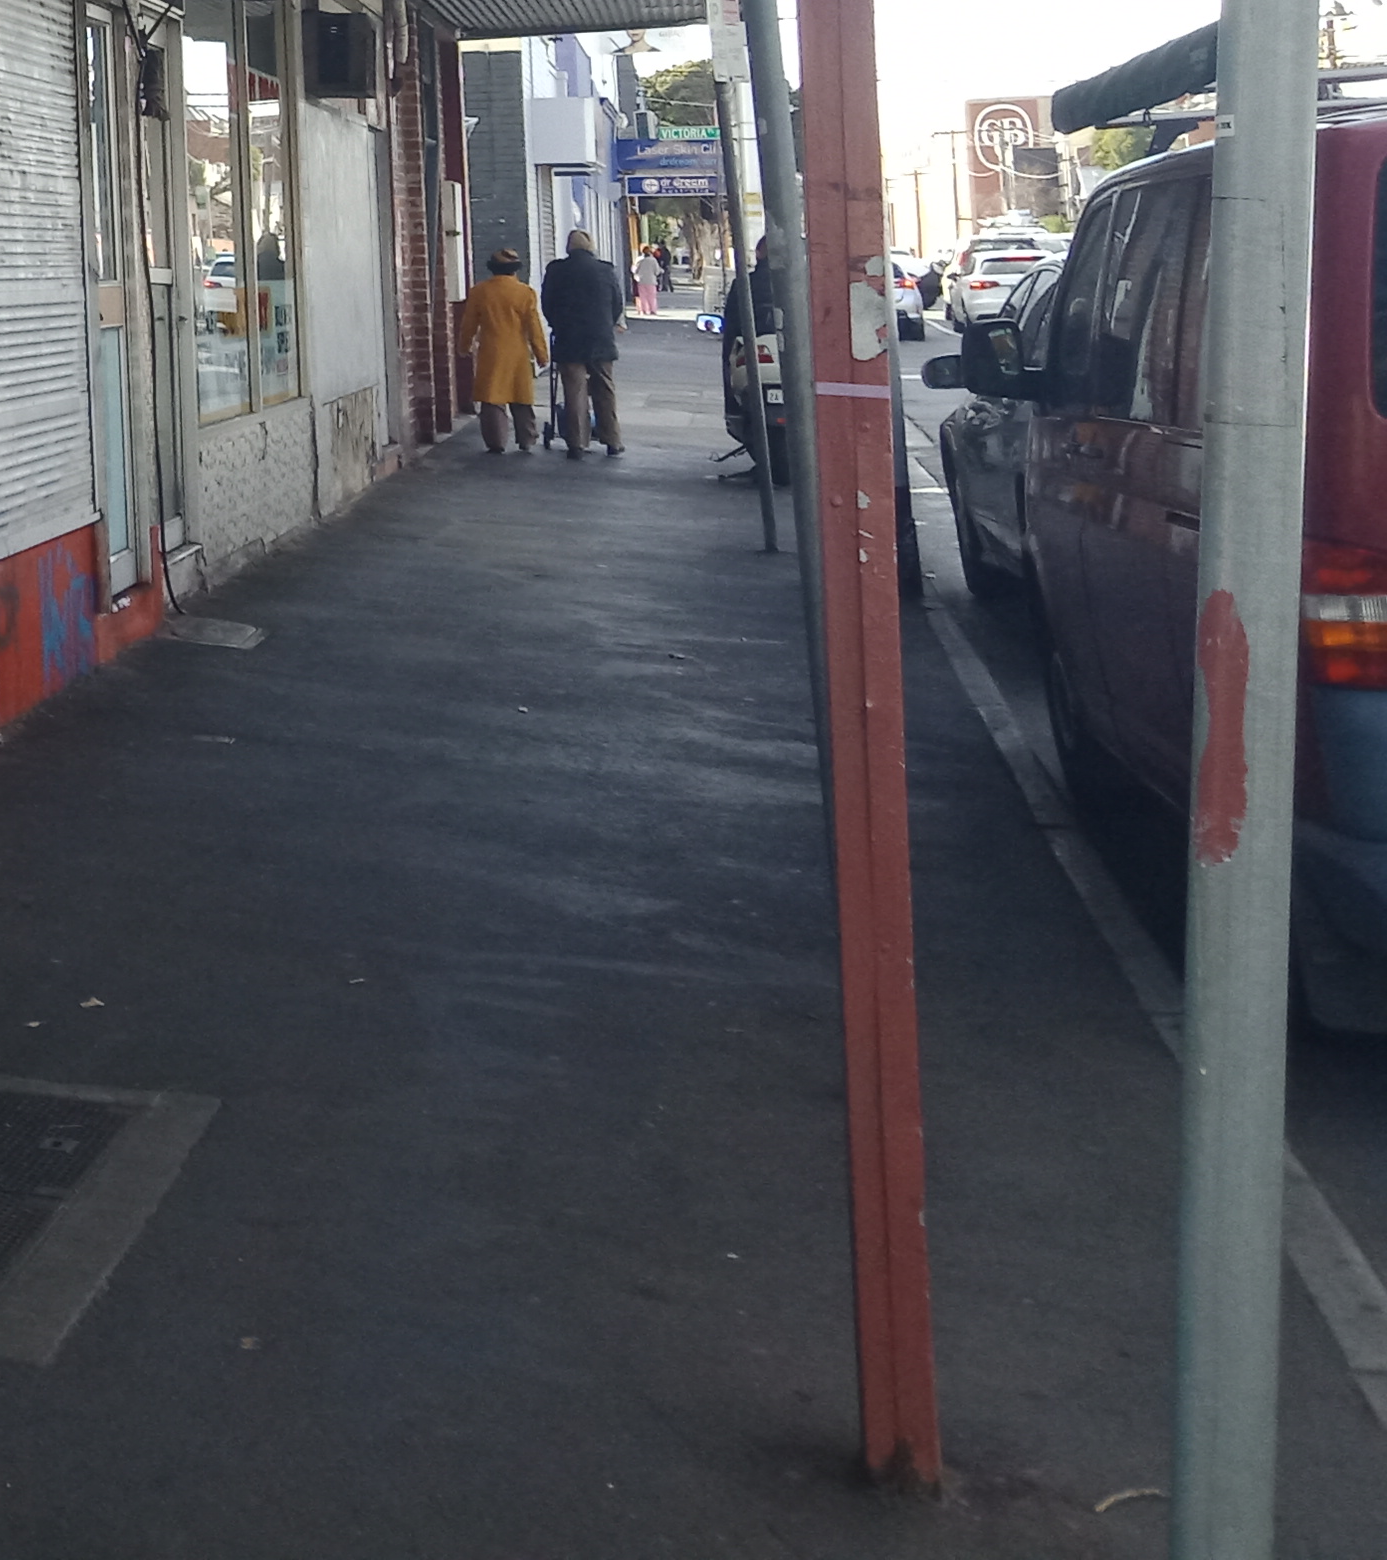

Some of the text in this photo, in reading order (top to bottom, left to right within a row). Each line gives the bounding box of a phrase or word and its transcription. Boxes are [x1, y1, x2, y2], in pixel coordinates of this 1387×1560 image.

[661, 127, 707, 139] VICTORIA
[637, 143, 669, 156] Laser
[673, 143, 698, 155] Skin
